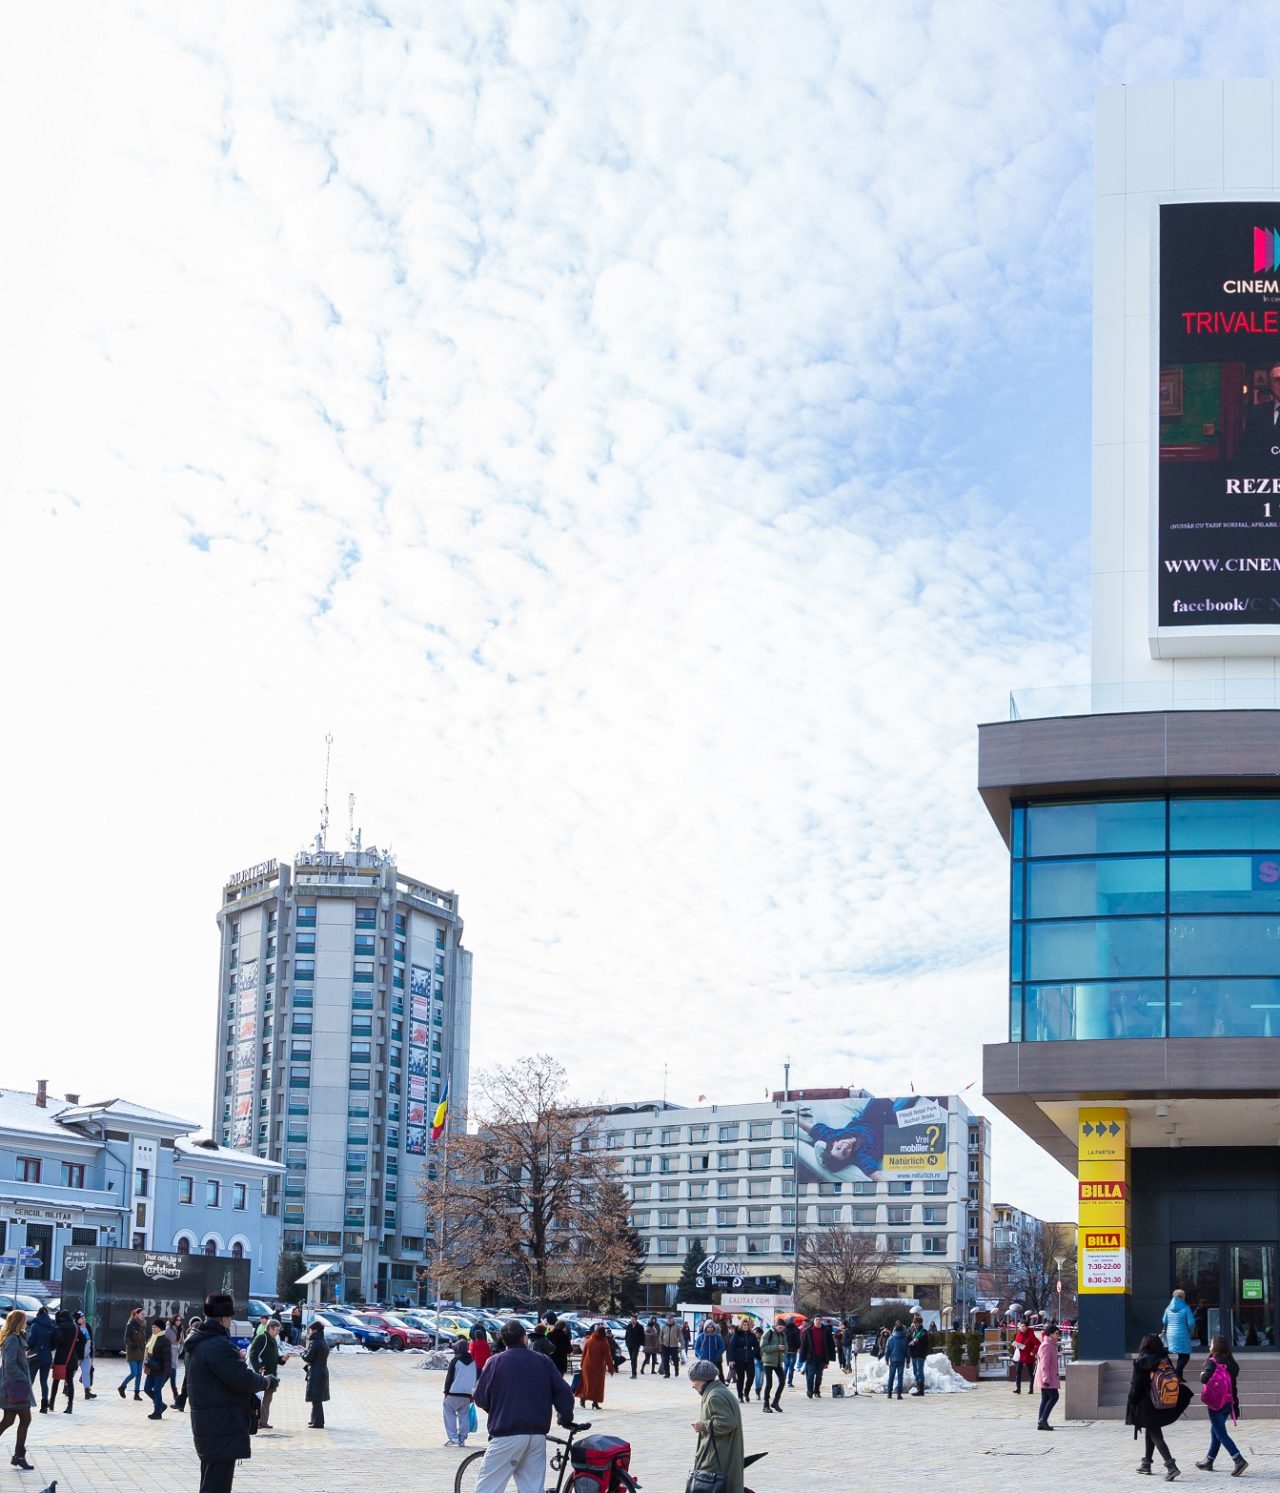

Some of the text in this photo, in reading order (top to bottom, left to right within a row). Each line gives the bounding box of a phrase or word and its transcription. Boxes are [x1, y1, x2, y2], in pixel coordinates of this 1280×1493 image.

[1181, 311, 1278, 334] TRIVALE
[900, 1144, 929, 1152] mobilier
[1081, 1185, 1122, 1198] BILLA
[1088, 1236, 1118, 1246] BILLA
[143, 1260, 182, 1280] Carlsberg
